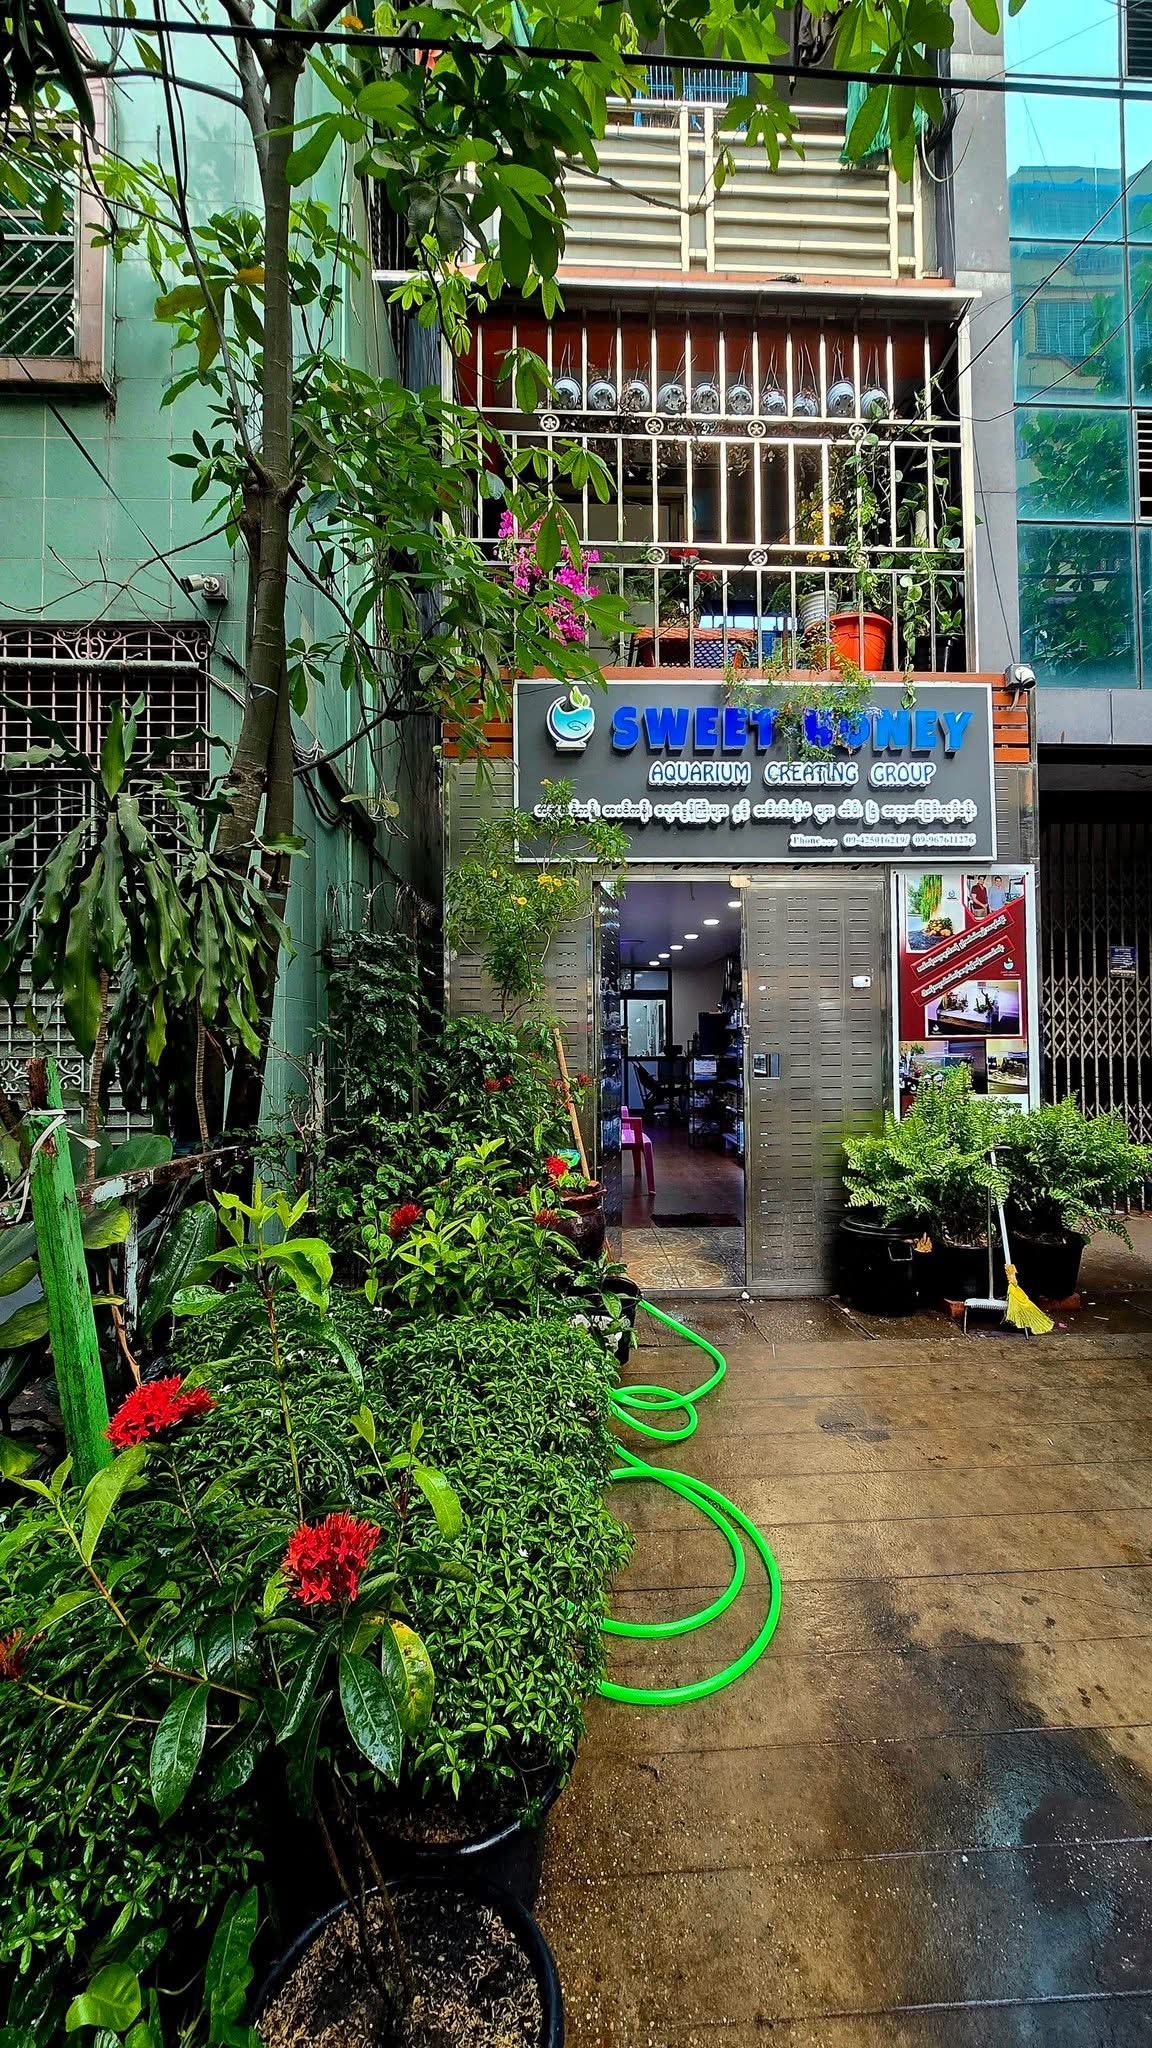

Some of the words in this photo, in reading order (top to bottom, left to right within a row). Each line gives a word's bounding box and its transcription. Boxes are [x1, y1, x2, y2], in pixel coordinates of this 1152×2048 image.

[612, 706, 777, 750] SWEET
[650, 762, 751, 783] AQUARIUM
[765, 762, 859, 784] CREATING
[870, 762, 936, 784] GROUP
